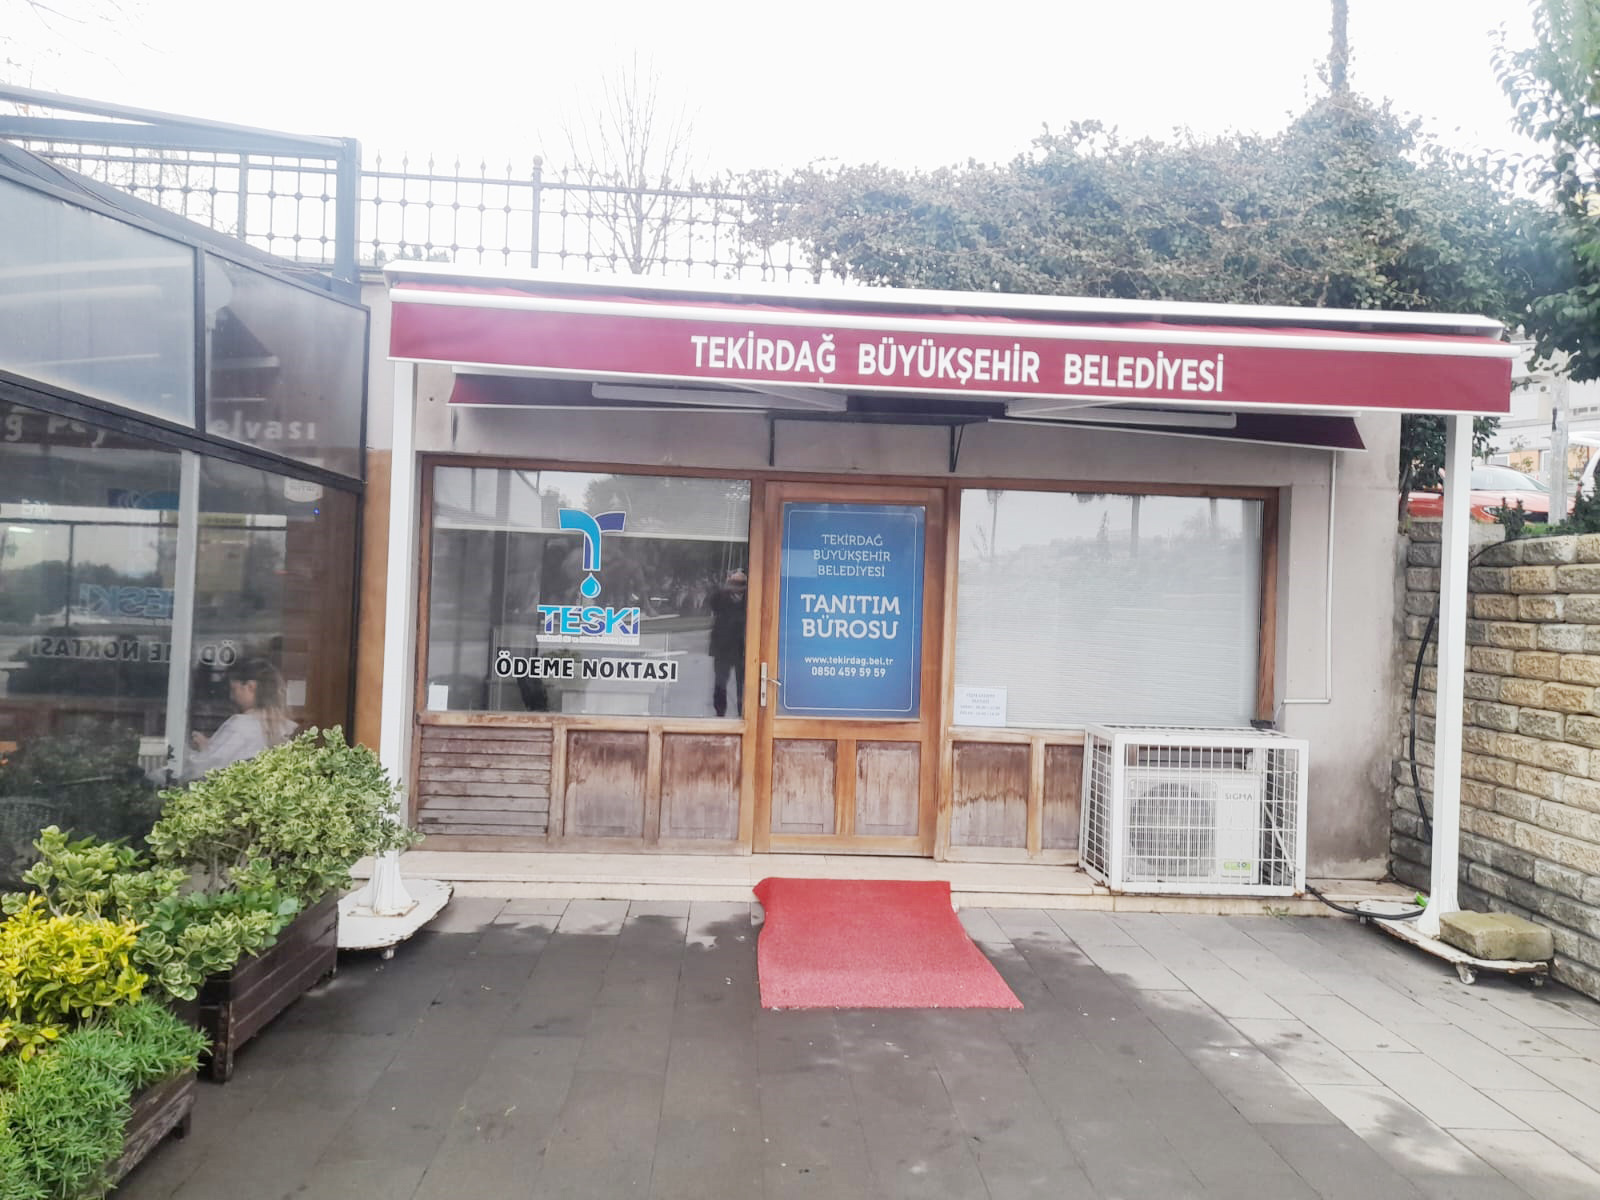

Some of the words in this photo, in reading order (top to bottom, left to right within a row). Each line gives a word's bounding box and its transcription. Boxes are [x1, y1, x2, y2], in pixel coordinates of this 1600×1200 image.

[690, 330, 836, 374] TEKİRDAĞ
[857, 338, 1040, 385] BÜYÜKŞEHİR
[1063, 350, 1224, 393] BELEDİYESİ
[821, 532, 883, 547] TEKİRDAĞ
[813, 547, 892, 563] BÜYÜKŞEHİR
[817, 564, 886, 578] BELEDİYESİ
[800, 593, 901, 615] TANITIM
[801, 614, 899, 640] BÜROSU
[495, 650, 574, 679] ÖDEME
[582, 658, 679, 682] NOKTASI
[804, 655, 894, 667] www.tekirdag.bel.tr
[811, 666, 836, 676] 0850
[838, 666, 857, 677] 459
[859, 667, 872, 677] 59
[873, 667, 887, 678] 59
